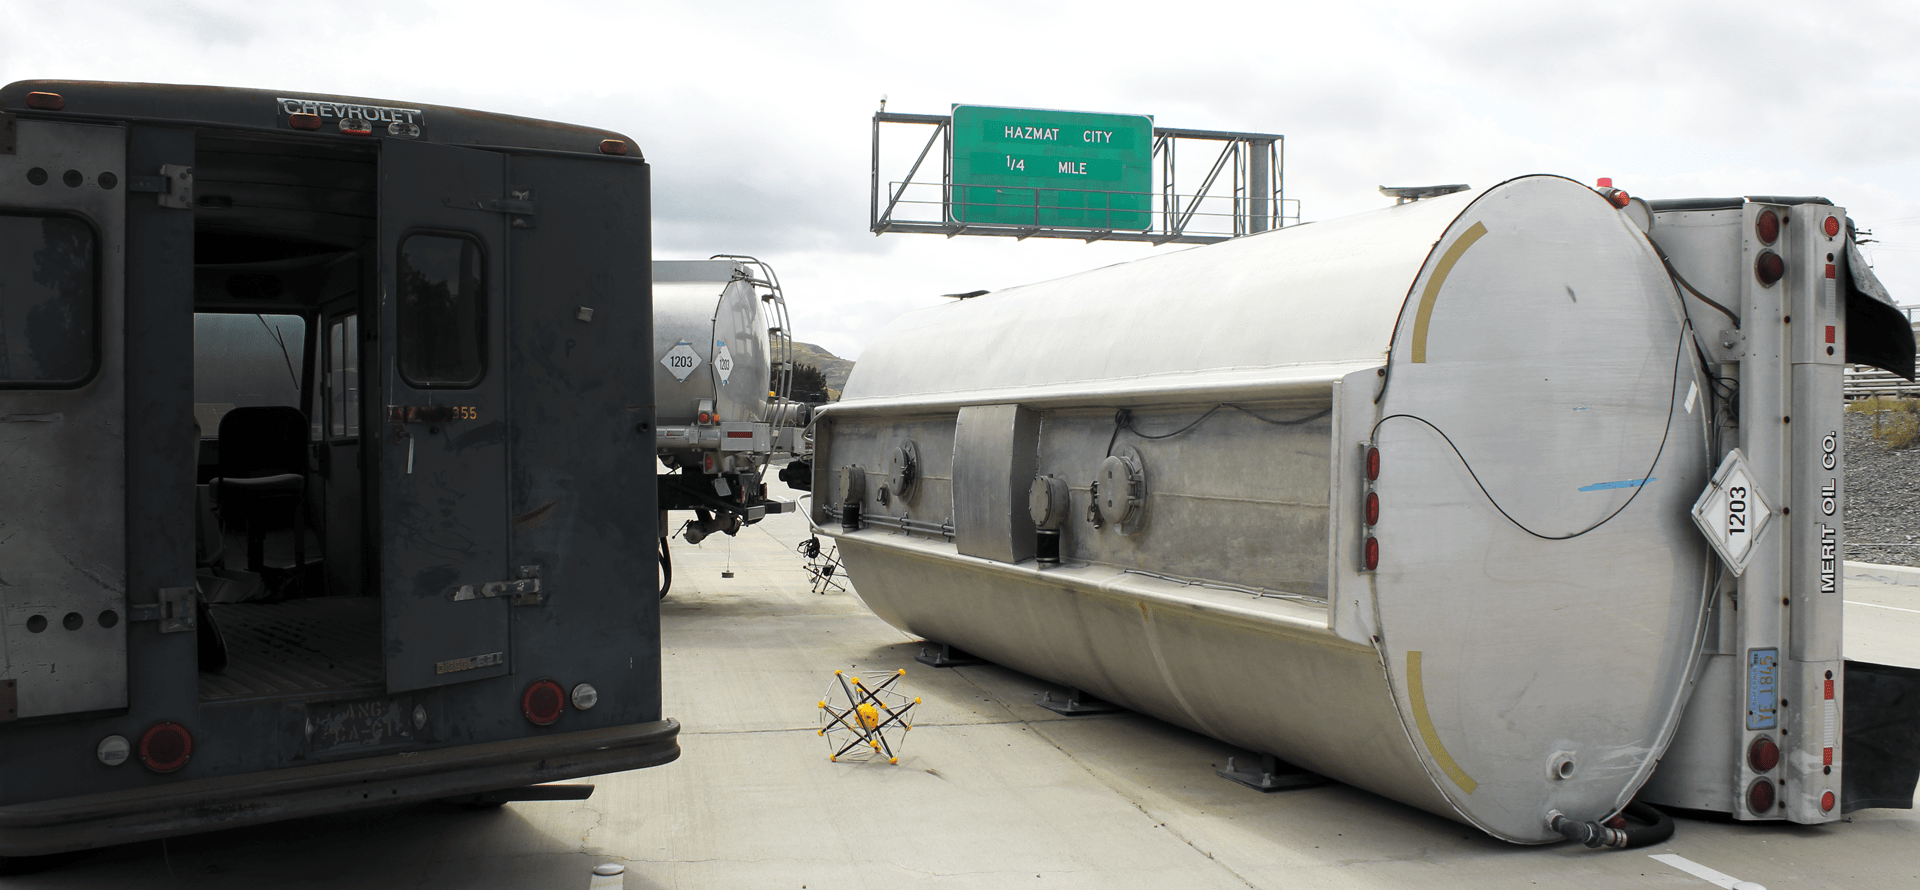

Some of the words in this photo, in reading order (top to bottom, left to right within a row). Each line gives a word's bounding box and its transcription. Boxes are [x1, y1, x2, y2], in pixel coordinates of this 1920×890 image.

[282, 99, 415, 124] CHEVROLET
[1004, 125, 1060, 141] HAZMAT
[1083, 130, 1113, 144] CITY
[1006, 154, 1025, 171] 1/4
[1058, 161, 1088, 175] MILE
[670, 355, 693, 368] 1203
[719, 359, 730, 371] 1203
[452, 406, 477, 420] 355
[1820, 430, 1836, 471] CO.
[1820, 477, 1836, 516] OIL
[1728, 486, 1746, 536] 1203
[1820, 523, 1836, 593] MERIT
[1759, 656, 1774, 694] 1845
